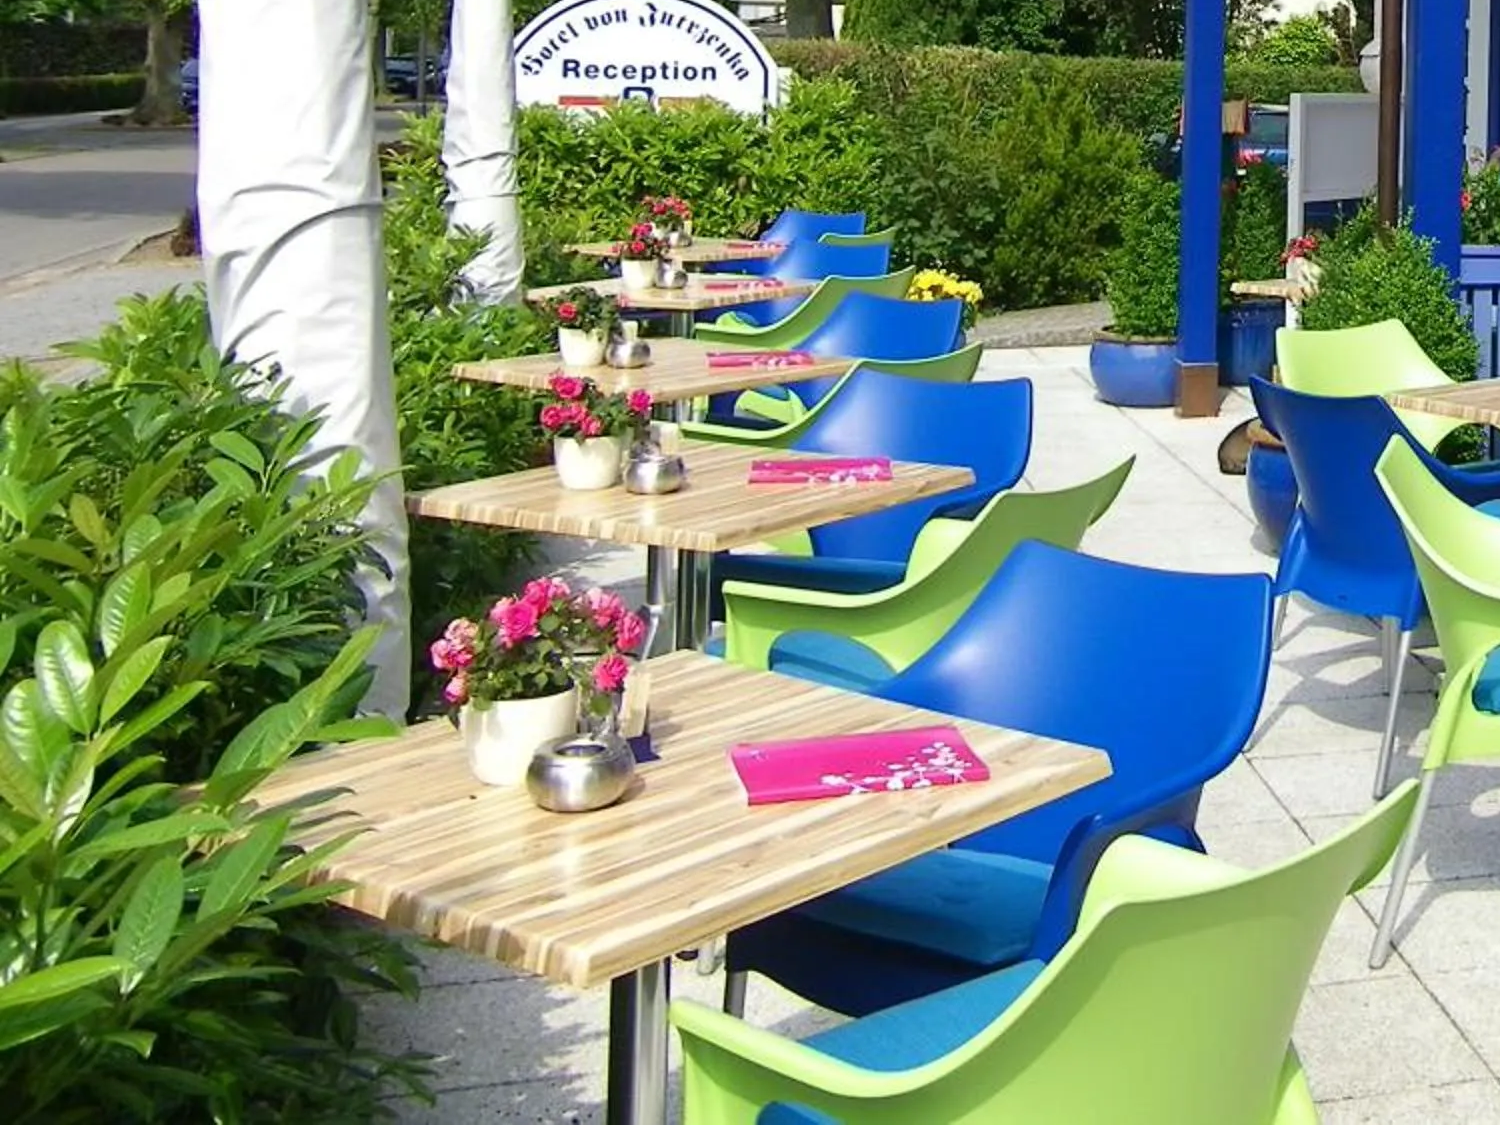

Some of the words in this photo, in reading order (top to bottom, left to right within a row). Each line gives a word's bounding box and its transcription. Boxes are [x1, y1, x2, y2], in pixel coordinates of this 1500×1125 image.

[520, 22, 579, 76] Hotel
[584, 8, 628, 31] von
[562, 59, 717, 84] Reception
